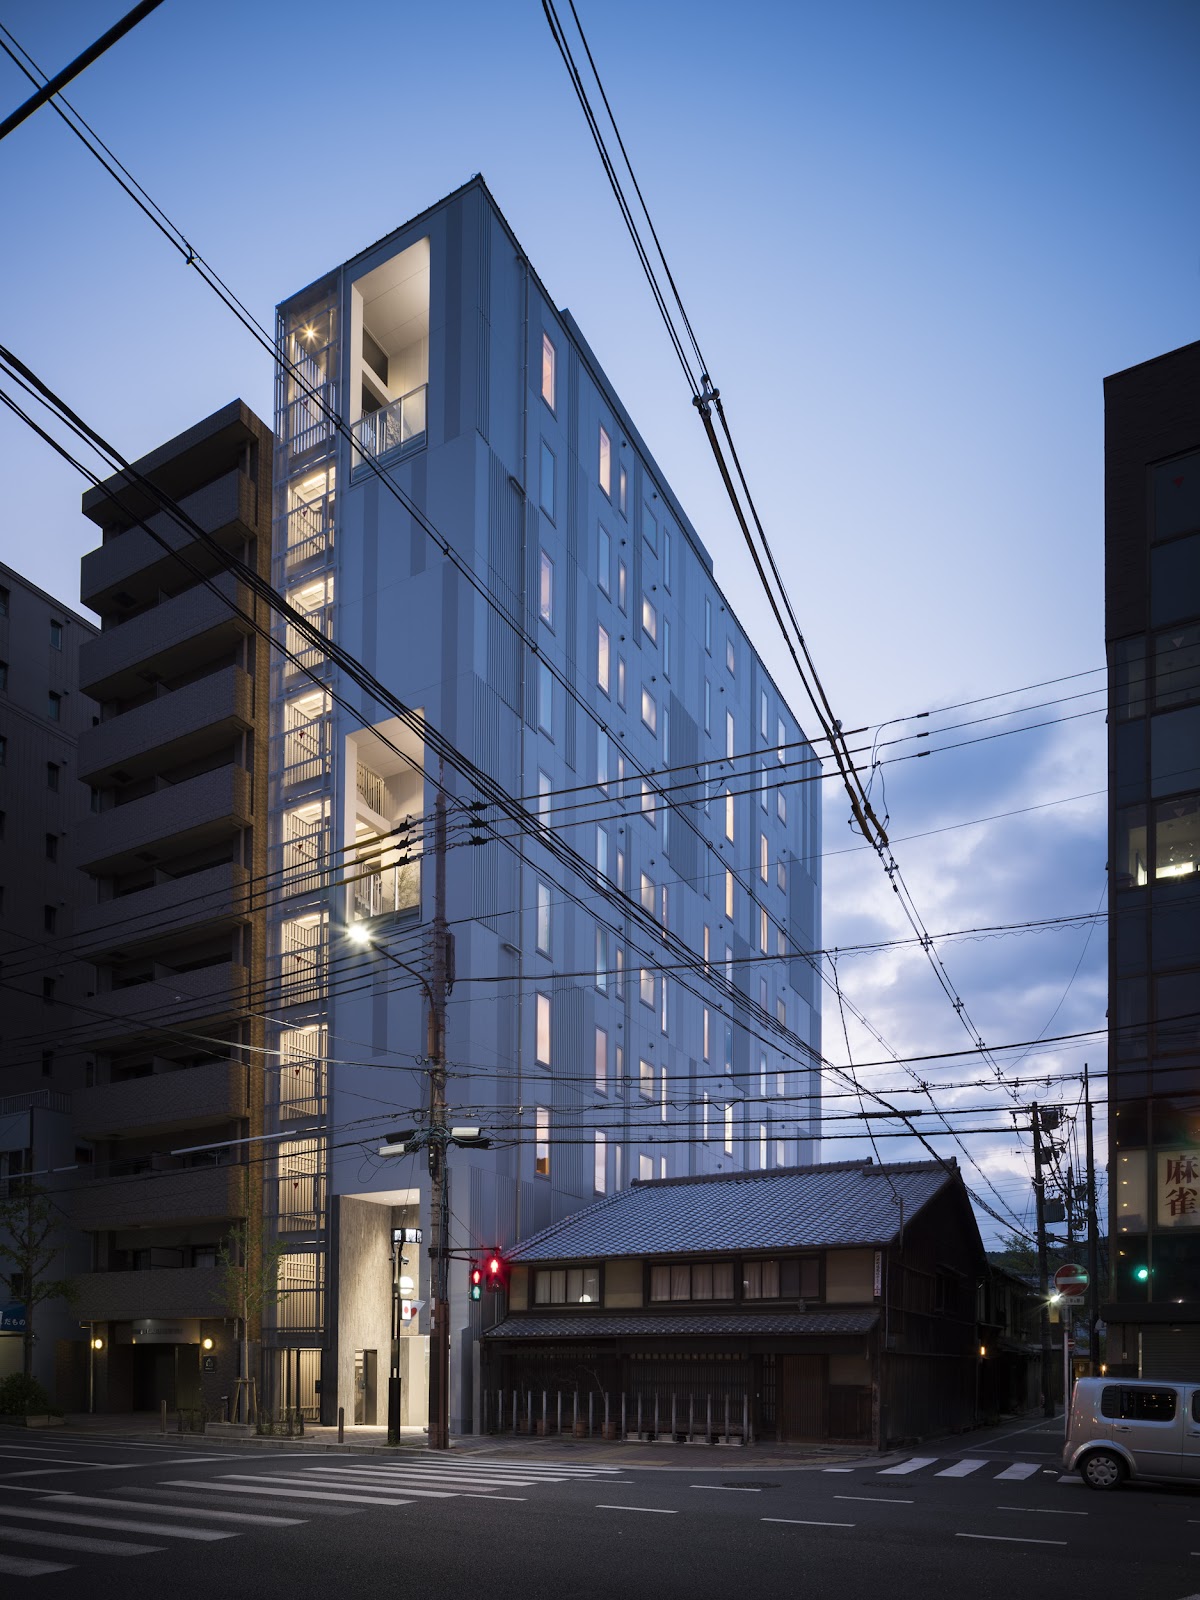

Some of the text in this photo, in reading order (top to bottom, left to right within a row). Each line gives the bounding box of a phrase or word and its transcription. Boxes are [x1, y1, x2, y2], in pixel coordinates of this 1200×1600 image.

[1165, 1155, 1199, 1216] 麻雀
[0, 1318, 26, 1326] だもの
